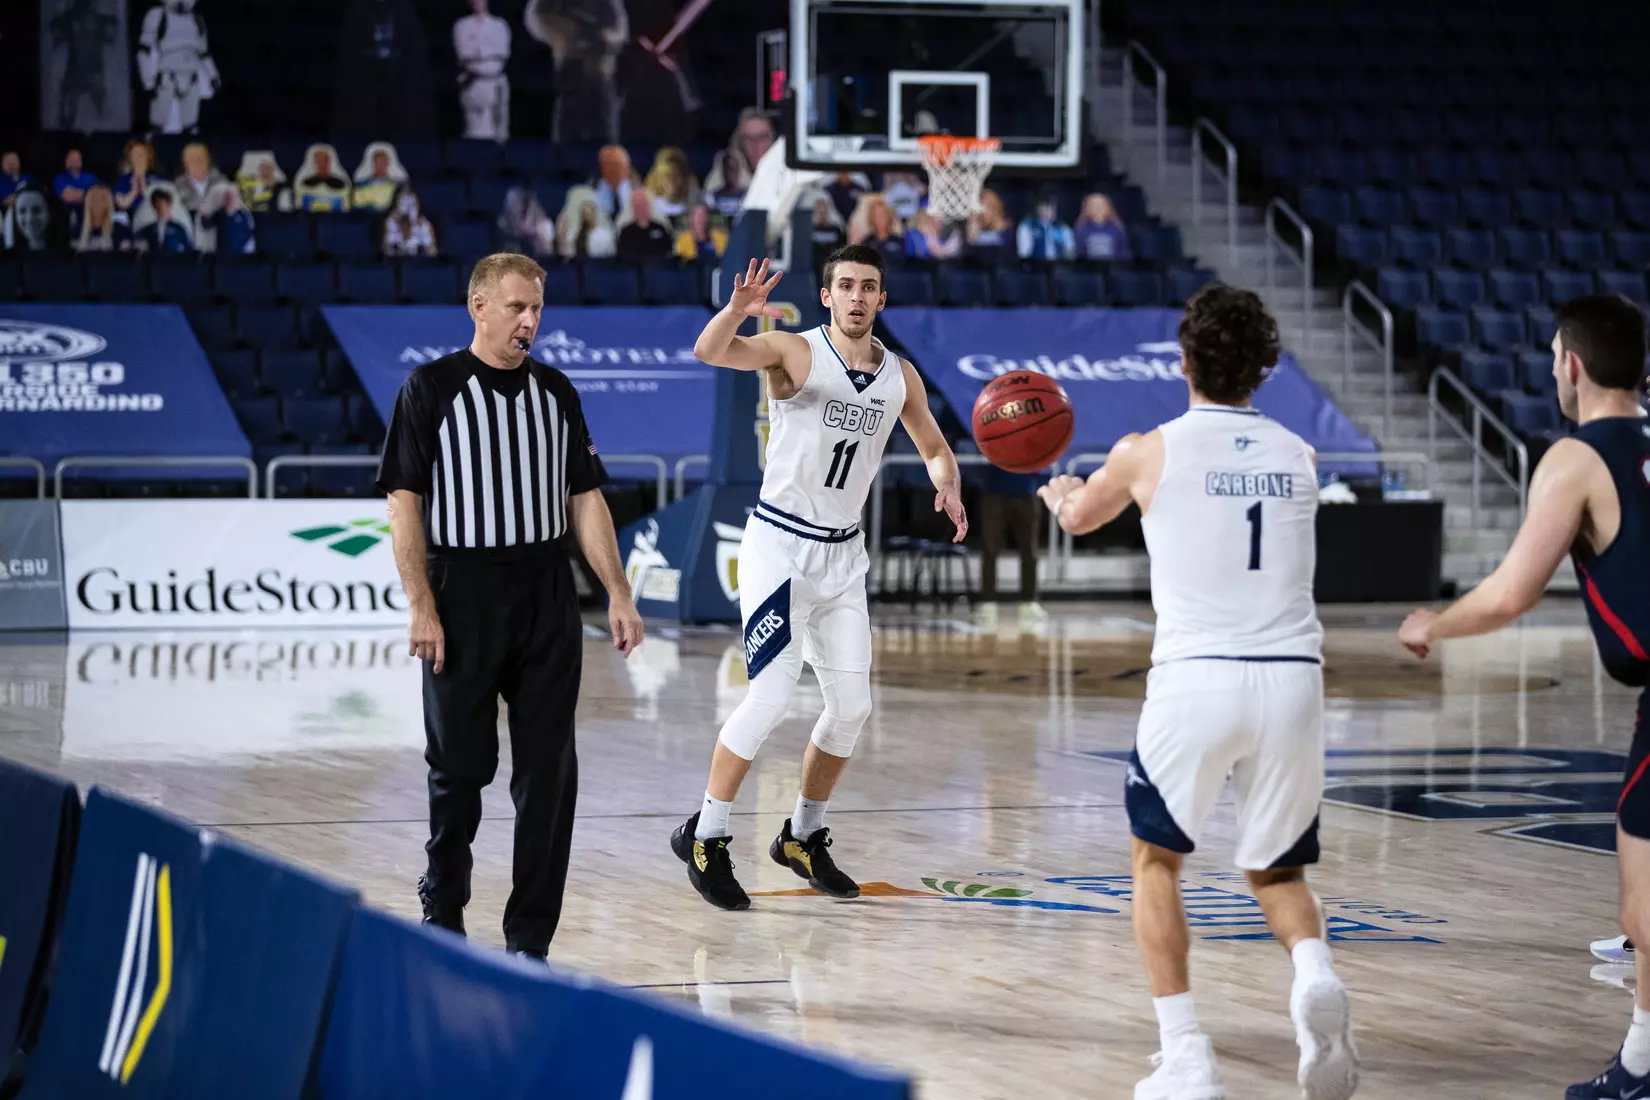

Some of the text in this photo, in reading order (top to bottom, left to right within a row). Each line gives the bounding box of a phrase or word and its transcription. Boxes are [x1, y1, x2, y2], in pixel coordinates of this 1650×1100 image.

[823, 399, 884, 436] CBU
[870, 397, 886, 407] WAC
[824, 438, 860, 490] 11
[1205, 471, 1293, 498] CARBONE
[1246, 500, 1262, 570] 1
[76, 566, 409, 615] GuideStone
